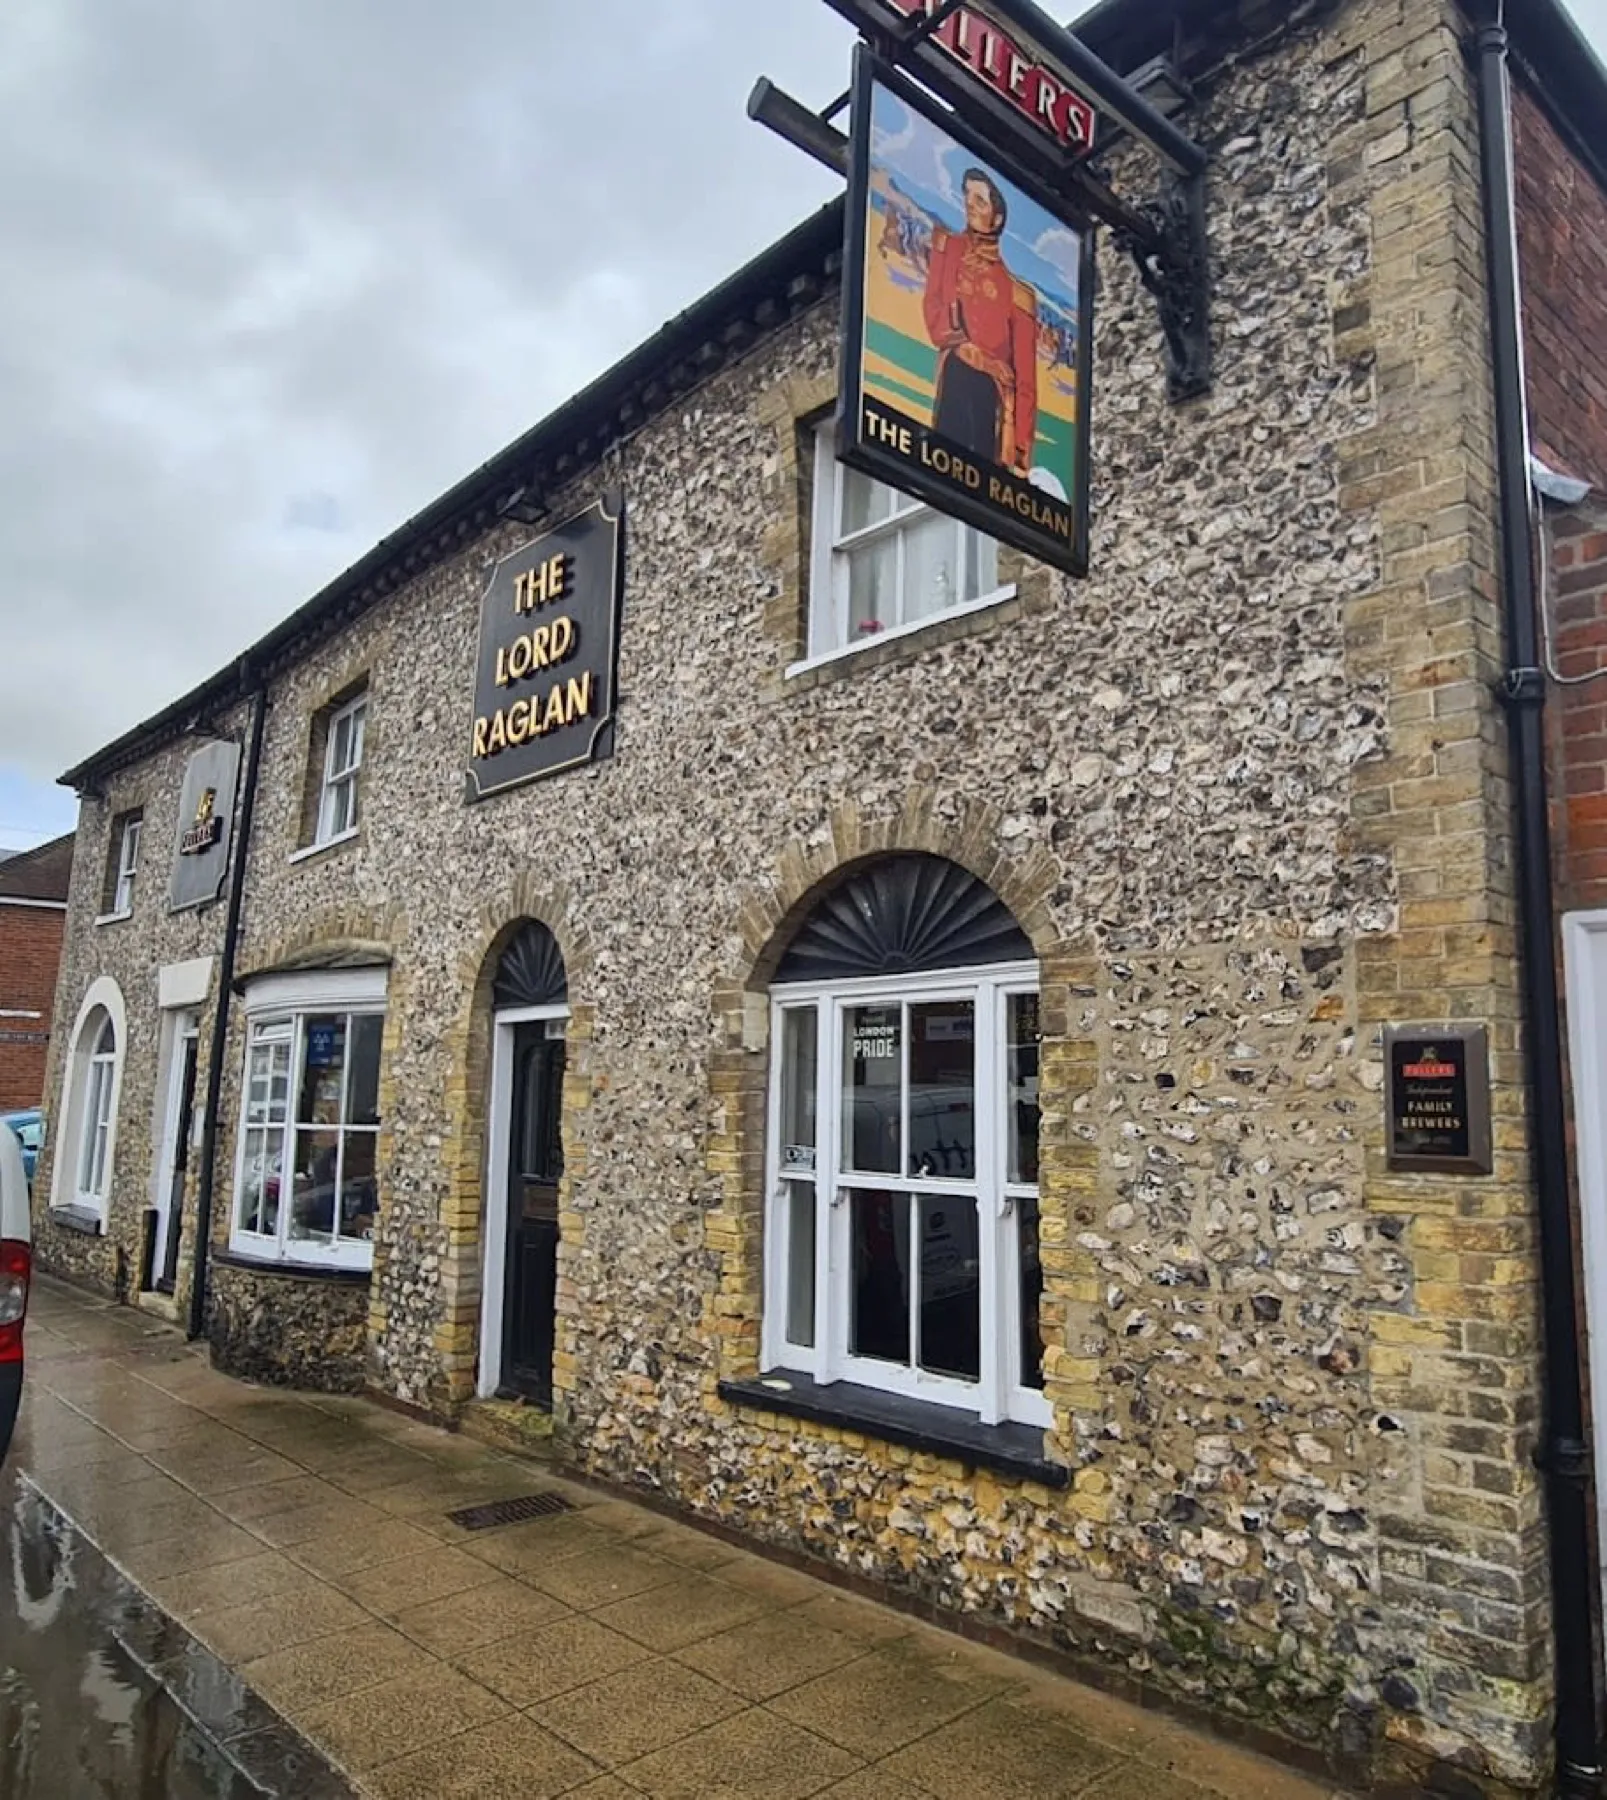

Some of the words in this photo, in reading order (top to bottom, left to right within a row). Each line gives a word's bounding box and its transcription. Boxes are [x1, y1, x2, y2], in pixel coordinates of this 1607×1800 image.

[865, 410, 911, 455] THE
[920, 439, 980, 489] LORD
[989, 476, 1070, 538] RAGLAN
[513, 552, 567, 614] THE
[495, 615, 573, 688] LORD
[472, 671, 591, 758] RAGLAN
[853, 1026, 895, 1036] LONDON
[853, 1038, 895, 1058] PRIDE
[1402, 1116, 1461, 1128] BREWERS
[1407, 1100, 1453, 1112] FAMILY
